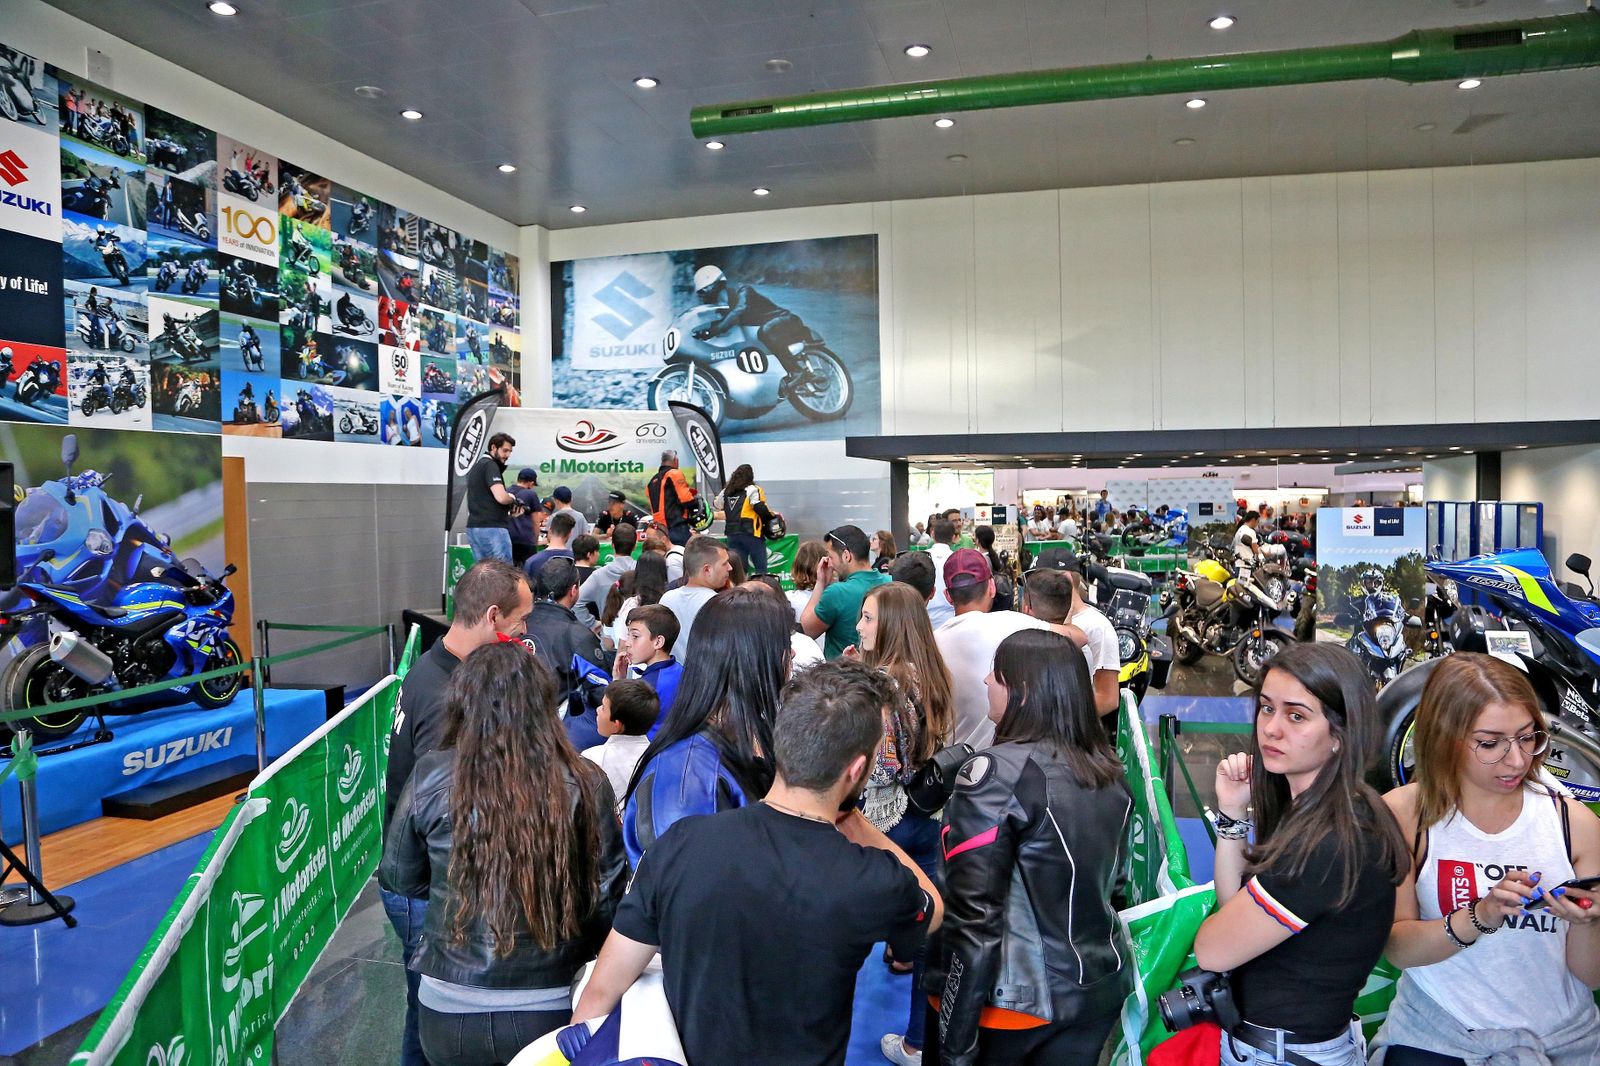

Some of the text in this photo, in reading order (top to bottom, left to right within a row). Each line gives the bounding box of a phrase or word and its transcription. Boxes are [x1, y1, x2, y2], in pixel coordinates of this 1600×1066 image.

[0, 189, 52, 216] ZUKI
[221, 206, 276, 245] 100
[10, 276, 22, 290] of
[24, 277, 49, 295] Life!
[394, 354, 407, 369] 50
[589, 343, 657, 358] SUZUKI
[710, 349, 735, 361] SUZUKI
[739, 350, 763, 374] 10
[458, 418, 482, 469] HJC
[540, 458, 645, 473] el Motorista
[122, 726, 233, 776] SUZUKI
[332, 786, 376, 852] el Motorista
[281, 844, 327, 921] Motorista
